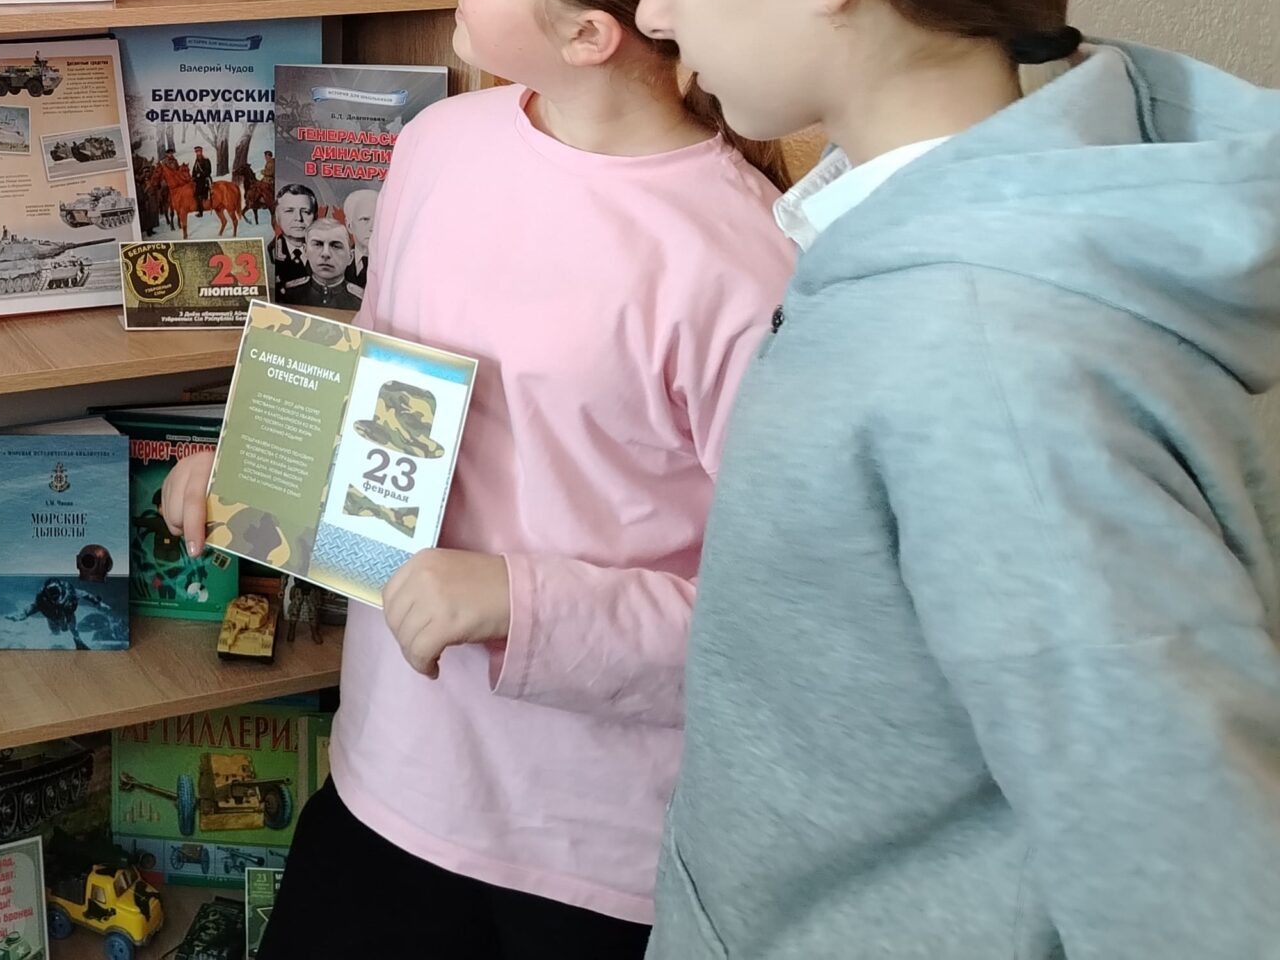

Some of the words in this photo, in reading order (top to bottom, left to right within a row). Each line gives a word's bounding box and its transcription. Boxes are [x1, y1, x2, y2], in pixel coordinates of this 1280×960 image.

[180, 63, 221, 73] Валерий
[225, 63, 254, 74] Чудов
[152, 89, 275, 102] БЕЛОРУССКИ
[145, 109, 275, 124] ФЕЛЬДМАРША
[297, 128, 399, 145] ГЕНЕРАЛЬСК
[312, 146, 393, 162] ДИНАСТИ
[305, 162, 317, 176] В
[322, 162, 388, 180] БЕЛАРУ
[128, 244, 166, 257] БЕЛАРУСЬ
[208, 253, 260, 285] 23
[199, 286, 259, 297] лютага
[250, 349, 257, 360] С
[259, 351, 286, 368] ДНЕМ
[287, 358, 341, 384] ЗАЩИТНИКА
[267, 367, 319, 391] ОТЕЧЕСТВА!
[362, 448, 418, 492] 23
[362, 480, 409, 504] февраля
[31, 512, 88, 527] МОРСКИЕ
[31, 526, 86, 539] ДЬЯВОЛЫ
